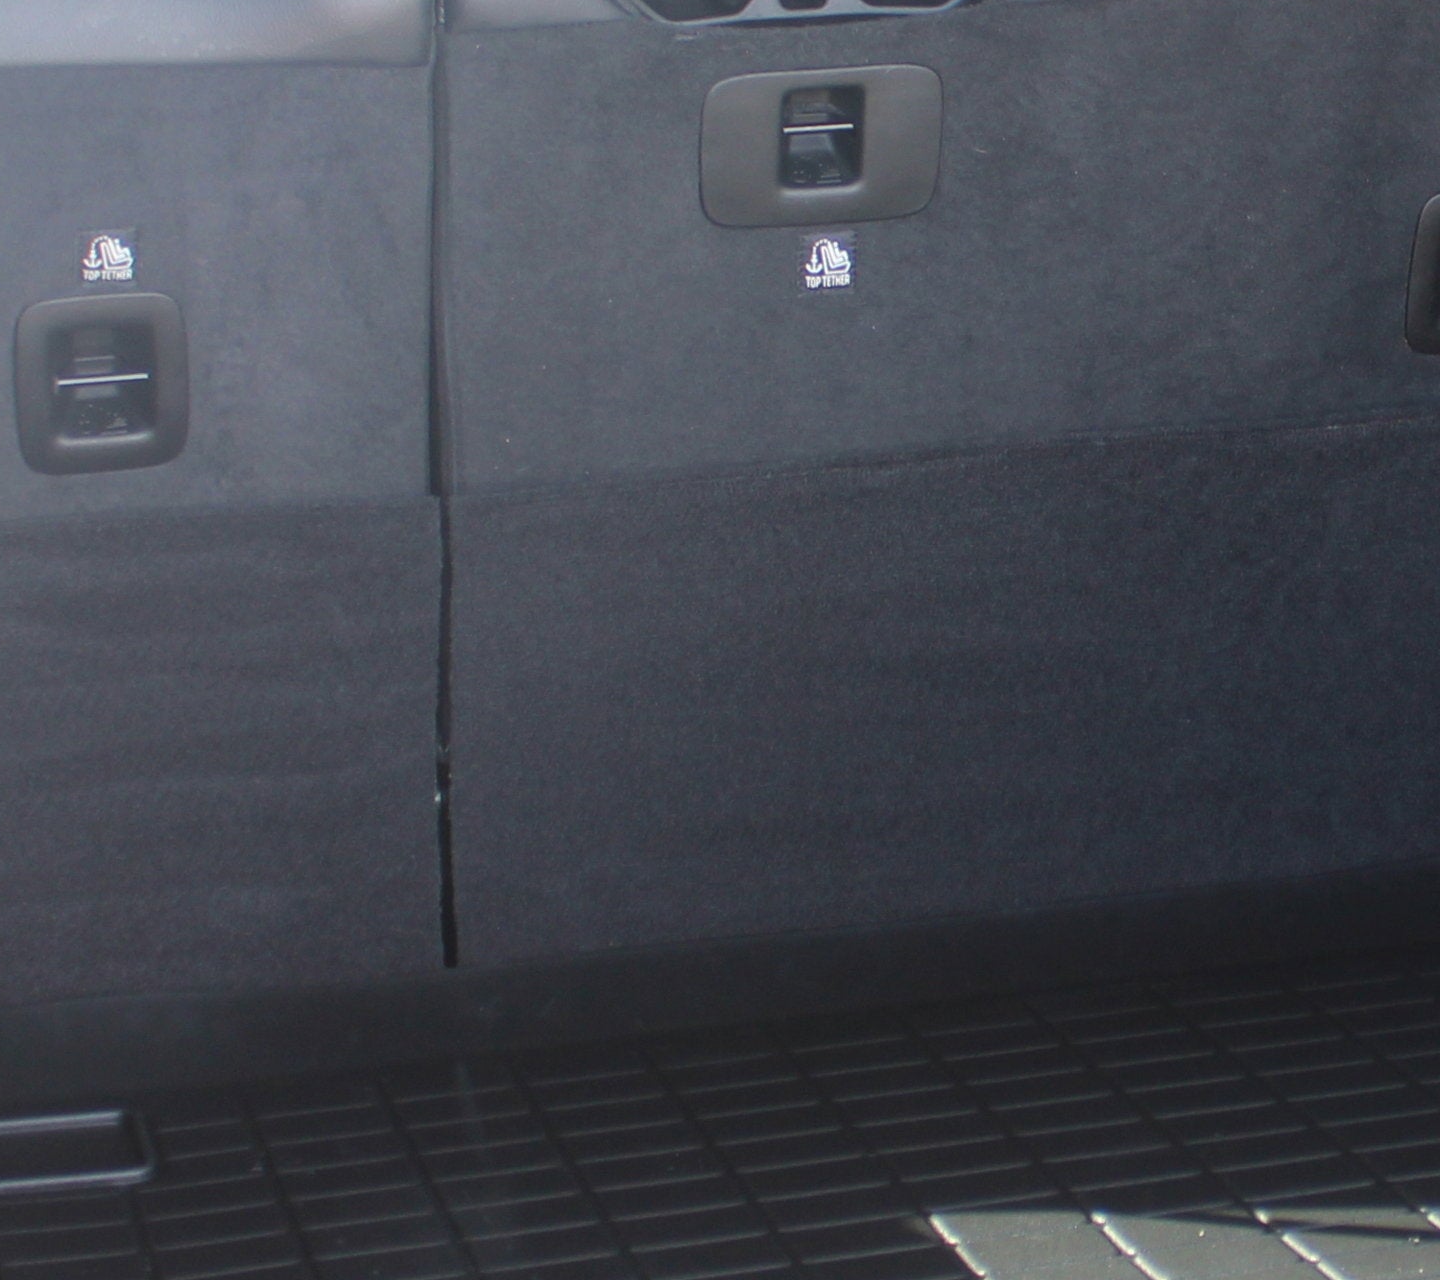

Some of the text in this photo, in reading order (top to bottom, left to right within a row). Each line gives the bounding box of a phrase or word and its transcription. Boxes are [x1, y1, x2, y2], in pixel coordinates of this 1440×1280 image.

[82, 268, 133, 281] TOP TETHER
[805, 273, 850, 288] TOP TETHER
